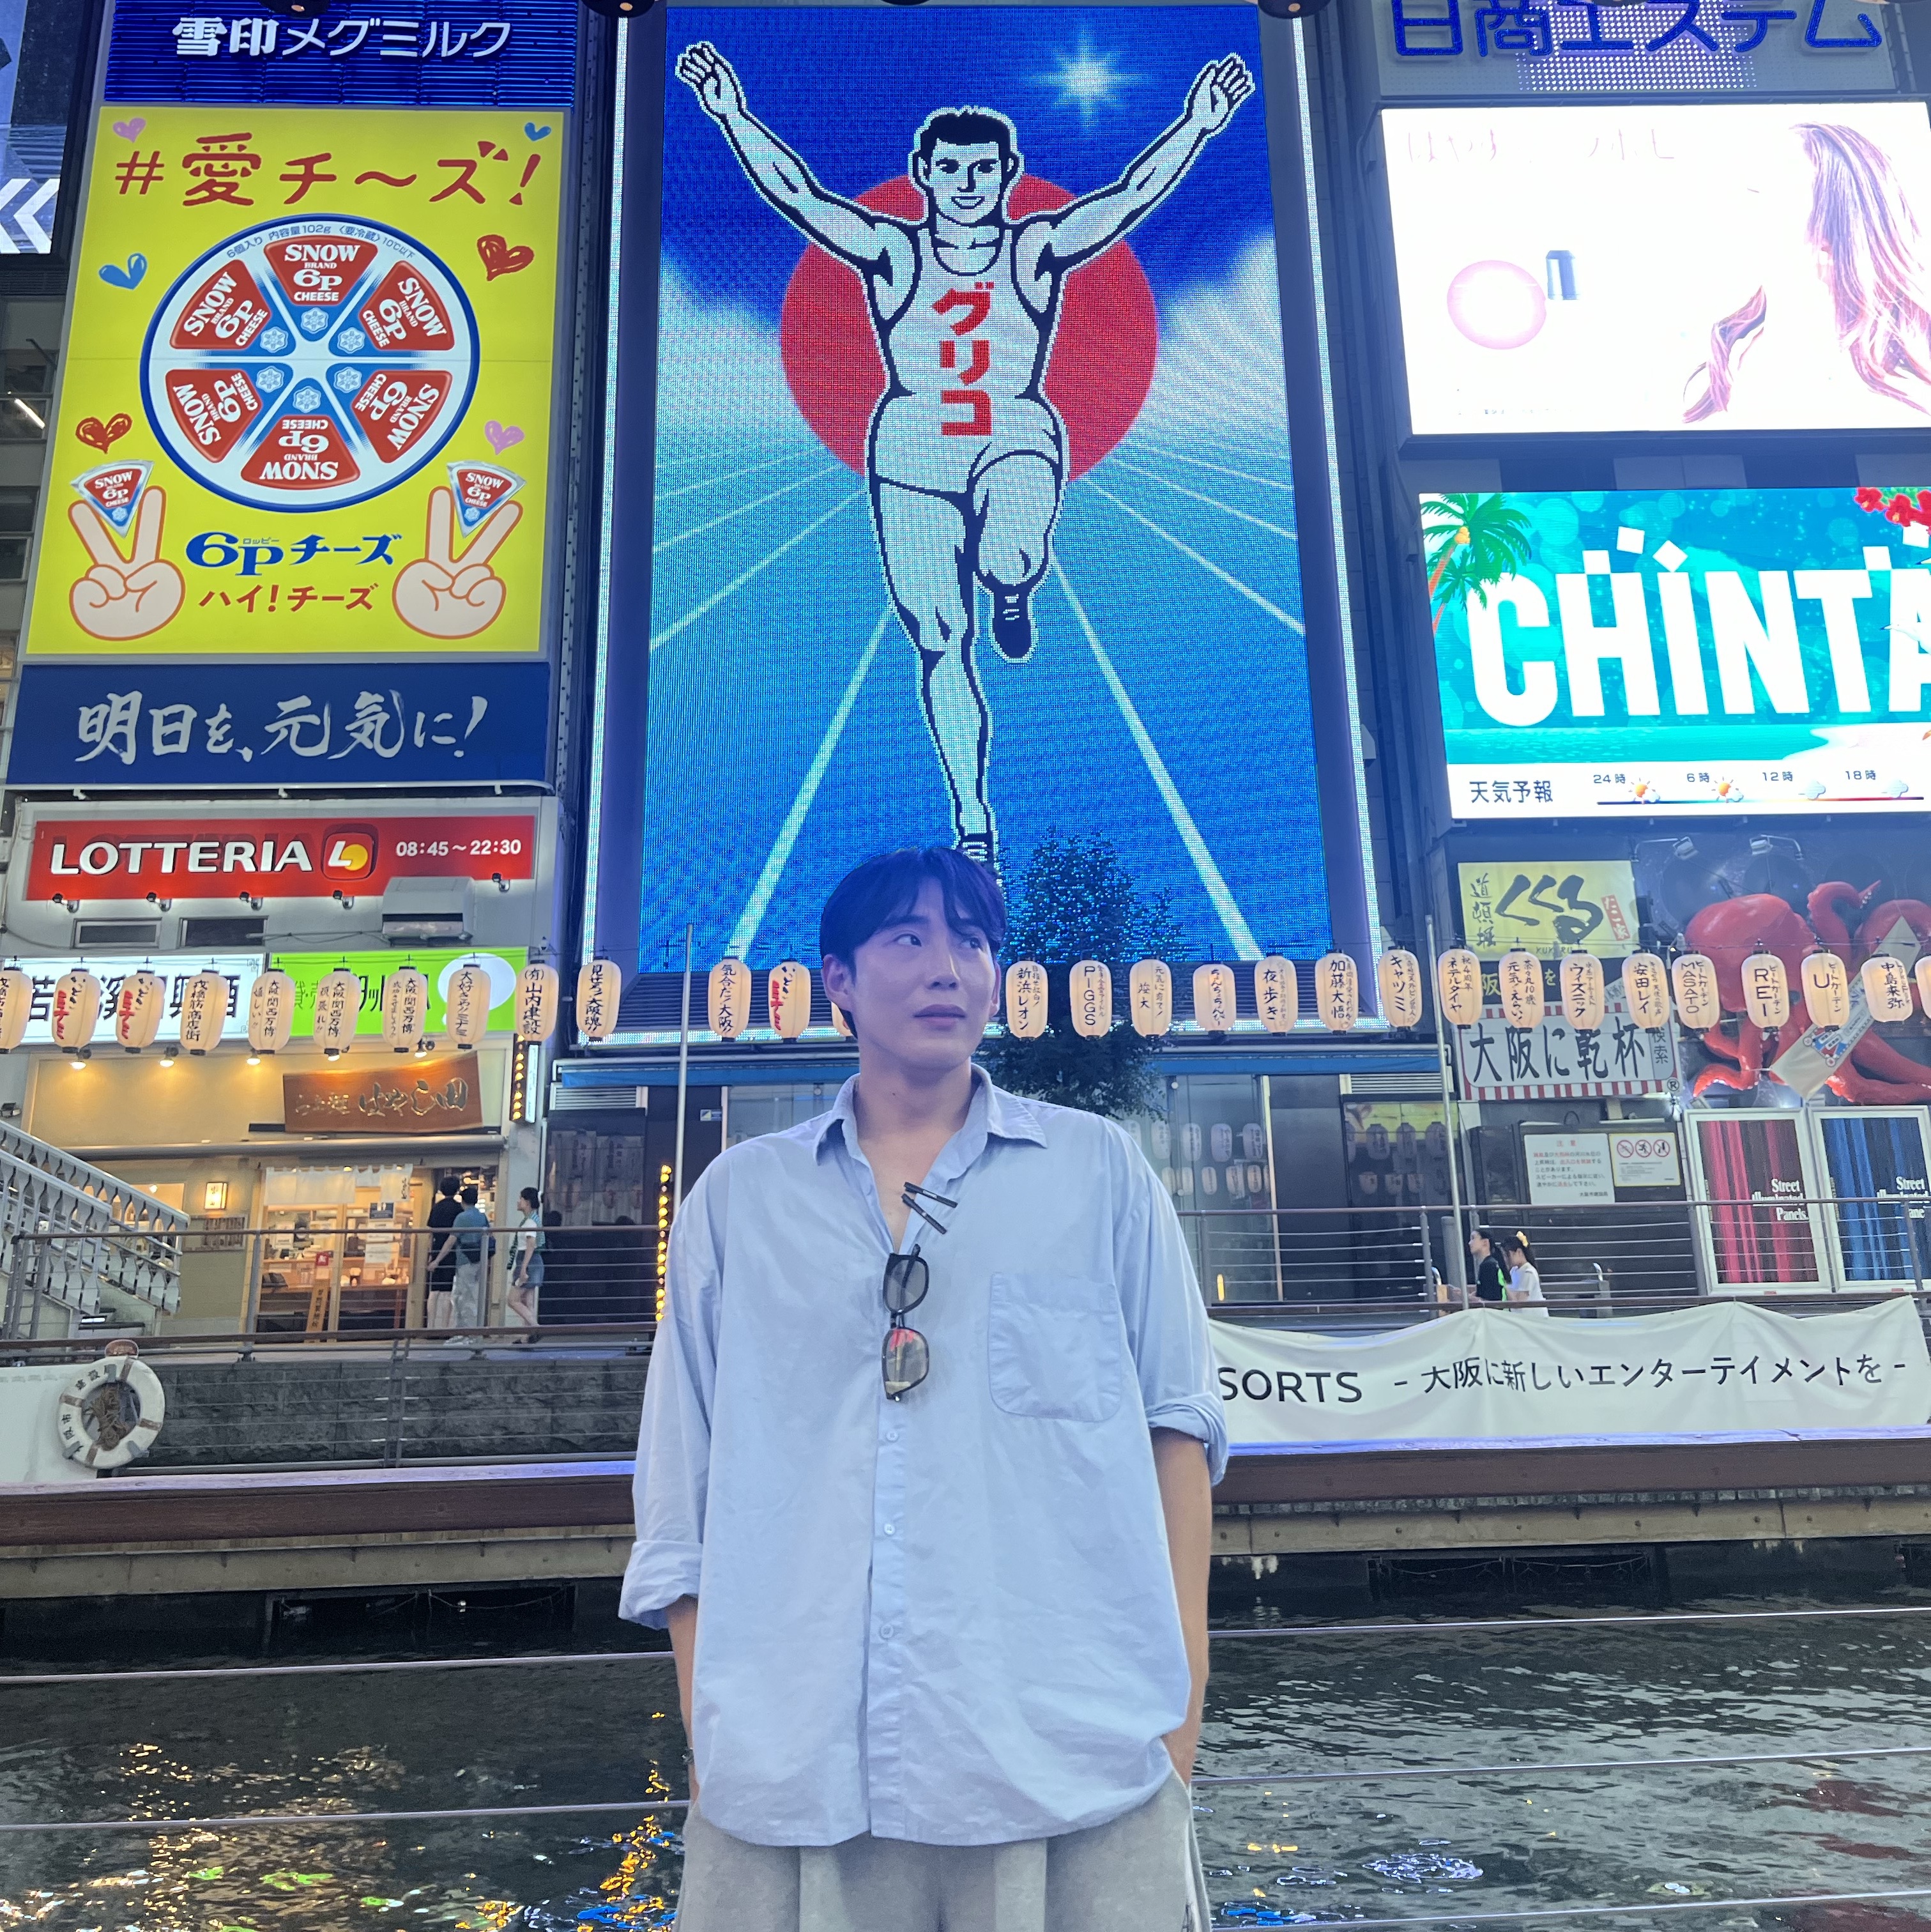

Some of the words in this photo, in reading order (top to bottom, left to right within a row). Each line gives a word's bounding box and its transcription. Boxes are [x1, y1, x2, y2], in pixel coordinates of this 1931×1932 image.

[173, 17, 511, 57] 雪印メグミルク
[227, 237, 263, 258] 6個入り
[269, 225, 331, 240] 内容量102g
[284, 244, 360, 261] SNOW
[293, 269, 342, 291] 6P
[294, 292, 339, 302] CHEESE
[183, 272, 237, 337] SNOW
[211, 298, 234, 325] BRAND
[215, 300, 254, 338] 6P
[379, 298, 407, 340] 6P
[397, 277, 446, 337] SNOW
[399, 300, 418, 327] BRAND
[235, 309, 268, 346] CHEESE
[362, 309, 390, 348] CHEESE
[931, 281, 994, 436] グリコ
[201, 393, 221, 422] BRAND
[214, 379, 241, 422] 6P
[231, 372, 258, 411] CHEESE
[355, 373, 387, 411] CHEESE
[370, 381, 408, 420] 6P
[390, 395, 413, 423] BRAND
[173, 383, 222, 445] SNOW
[282, 419, 328, 429] CHEESE
[387, 383, 439, 450] SNOW
[278, 430, 329, 454] 6P
[95, 471, 133, 489] SNOW
[259, 461, 339, 480] SNOW
[466, 472, 504, 489] SNOW
[102, 488, 128, 500] 6P
[467, 487, 491, 500] 6P
[1469, 780, 1553, 804] 天気予報
[50, 841, 312, 875] LOTTERIA
[1470, 873, 1496, 948] 道頓堀
[1495, 874, 1603, 944] くくる
[1016, 967, 1032, 1030] 新浜レオン
[1083, 966, 1095, 1025] PIGGS
[1263, 969, 1278, 1020] 夜歩き
[1329, 960, 1345, 1018] 加藤大悟
[1633, 962, 1650, 1014] 安田レイ
[1681, 962, 1699, 1014] MASATO
[1754, 969, 1773, 1017] REI
[1813, 973, 1829, 988] U
[187, 979, 210, 1041] 戎橋筋商店街
[264, 980, 280, 1037] 大阪関西万博
[328, 981, 345, 1037] 大阪関西万博
[402, 977, 418, 1034] 大阪関西万博
[523, 968, 544, 1034] (有)山内建設
[1771, 1178, 1801, 1192] Street
[1896, 1176, 1925, 1190] Street
[1217, 1367, 1362, 1402] SORTS
[1421, 1354, 1882, 1393] 大阪に新しいエンターテイメントを
